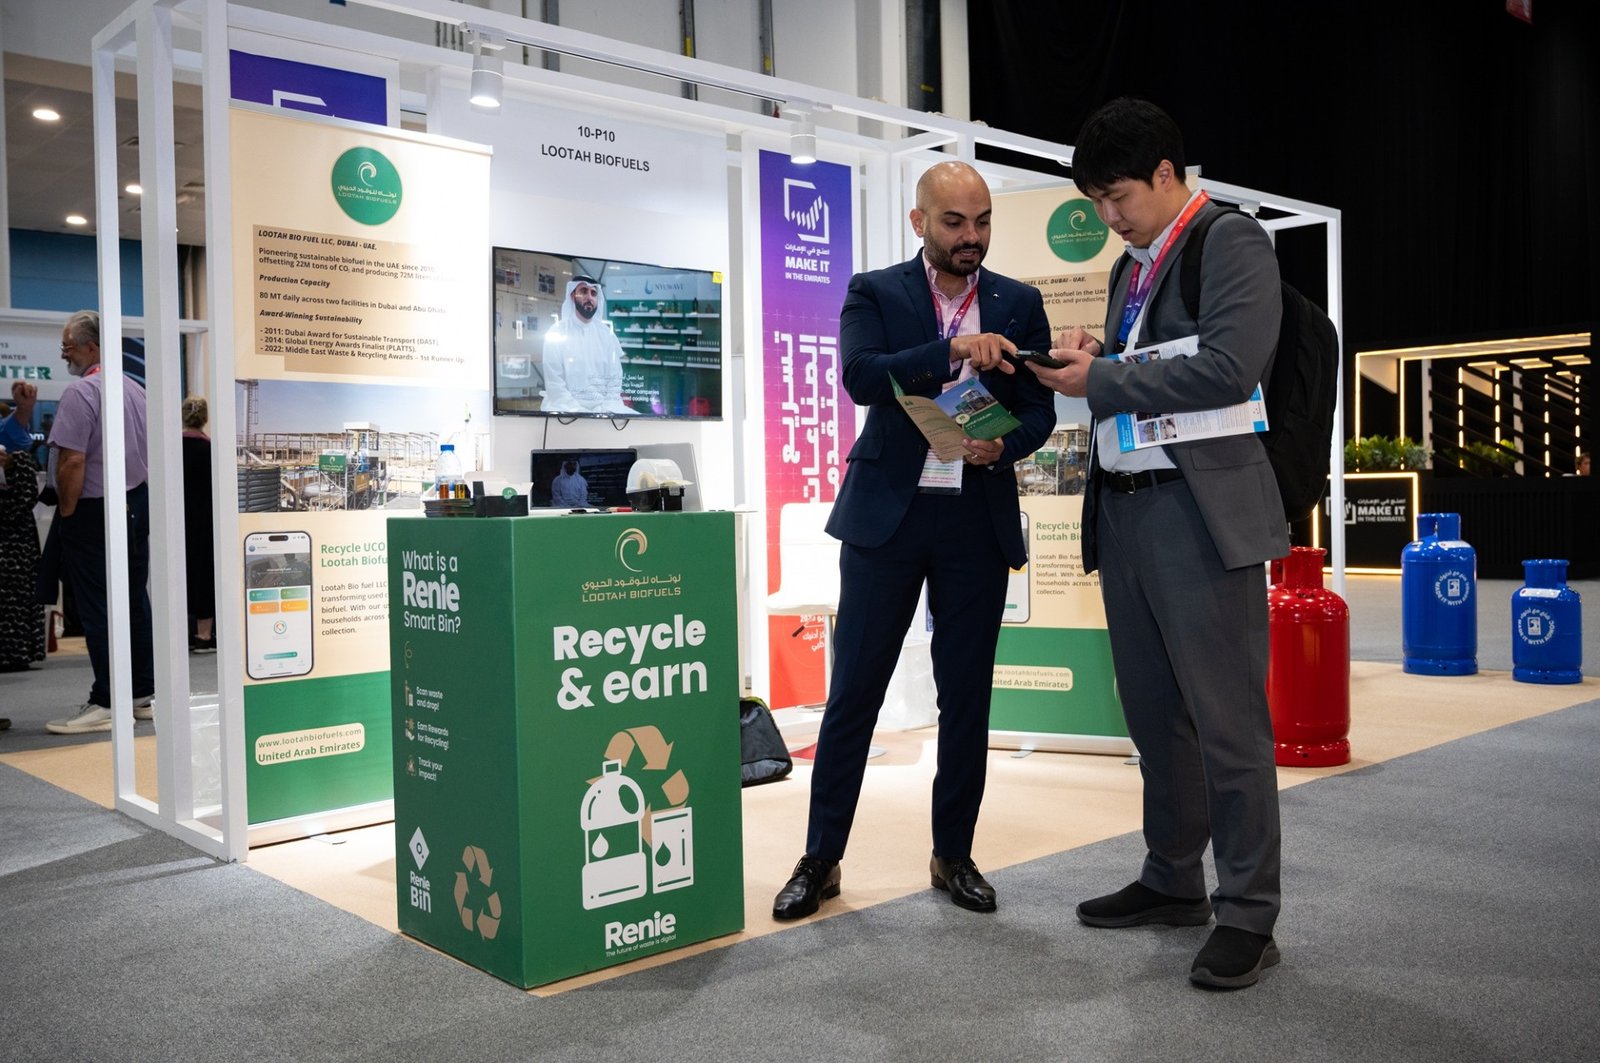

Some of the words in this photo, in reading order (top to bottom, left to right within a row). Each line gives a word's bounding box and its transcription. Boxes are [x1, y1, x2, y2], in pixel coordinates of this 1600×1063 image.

[578, 126, 616, 142] 10-P10
[541, 144, 591, 162] LOOTAH
[594, 152, 650, 172] BIOFUELS
[258, 230, 288, 240] LOOTAH
[321, 238, 335, 246] LLC,
[337, 239, 358, 248] DUBAI
[363, 242, 377, 250] UAE.
[259, 248, 298, 259] Pioneering
[299, 252, 340, 262] sustainable
[342, 256, 365, 265] biofuel
[374, 260, 385, 268] the
[785, 256, 818, 272] MAKE
[820, 260, 830, 272] IT
[259, 257, 294, 268] offsetting
[365, 268, 398, 279] producing
[260, 274, 298, 284] Production
[300, 278, 330, 288] Capacity
[785, 272, 792, 280] IN
[792, 272, 804, 281] THE
[804, 274, 830, 284] EMIRATES
[283, 294, 300, 303] daily
[302, 296, 324, 304] across
[341, 299, 368, 307] facilities
[378, 302, 397, 310] Dubai
[1075, 296, 1105, 304] producing
[260, 310, 313, 321] Award-Winning
[315, 314, 362, 324] Sustainability
[264, 327, 284, 336] 2011:
[285, 328, 306, 336] Dubai
[307, 330, 330, 338] Award
[332, 331, 343, 339] for
[344, 333, 381, 342] Sustainable
[383, 336, 415, 345] Transport
[285, 337, 307, 346] Global
[309, 339, 334, 348] Energy
[335, 341, 360, 349] Awards
[285, 346, 309, 354] Middle
[328, 349, 349, 357] Waste
[358, 351, 387, 360] Recycling
[0, 365, 52, 380] NTER
[774, 330, 800, 464] تسريع
[819, 336, 840, 501] المتقدم
[1358, 506, 1391, 515] MAKE
[1394, 506, 1406, 515] IT
[1036, 522, 1070, 532] Recycle
[321, 543, 361, 556] Recycle
[364, 542, 385, 552] UCO
[321, 556, 358, 568] Lootah
[402, 550, 434, 571] What
[436, 550, 446, 571] is
[449, 556, 458, 572] a
[321, 593, 366, 602] transforming
[402, 571, 460, 612] Renie
[582, 591, 626, 602] LOOTAH
[630, 587, 681, 599] BIOFUELS
[321, 605, 347, 614] biofuel.
[321, 616, 362, 624] households
[404, 611, 436, 630] Smart
[438, 614, 460, 634] Bin?
[322, 627, 357, 636] collection.
[553, 614, 706, 665] Recycle
[556, 667, 595, 710] &
[603, 661, 708, 704] earn
[1035, 680, 1069, 688] Emirates
[416, 686, 428, 696] Scan
[428, 690, 443, 699] waste
[416, 699, 426, 707] and
[427, 702, 440, 712] drop!
[417, 721, 428, 731] Earn
[428, 724, 449, 736] Rewards
[258, 728, 362, 748] www.lootahbiofuels.com
[258, 750, 291, 762] United
[294, 746, 317, 758] Arab
[320, 741, 360, 753] Emirates
[418, 757, 431, 768] Track
[432, 762, 443, 771] your
[410, 870, 431, 891] Renie
[411, 885, 431, 913] Bin
[605, 911, 676, 950] Renie
[616, 946, 632, 955] future
[639, 940, 654, 948] waste
[661, 934, 677, 943] digital
